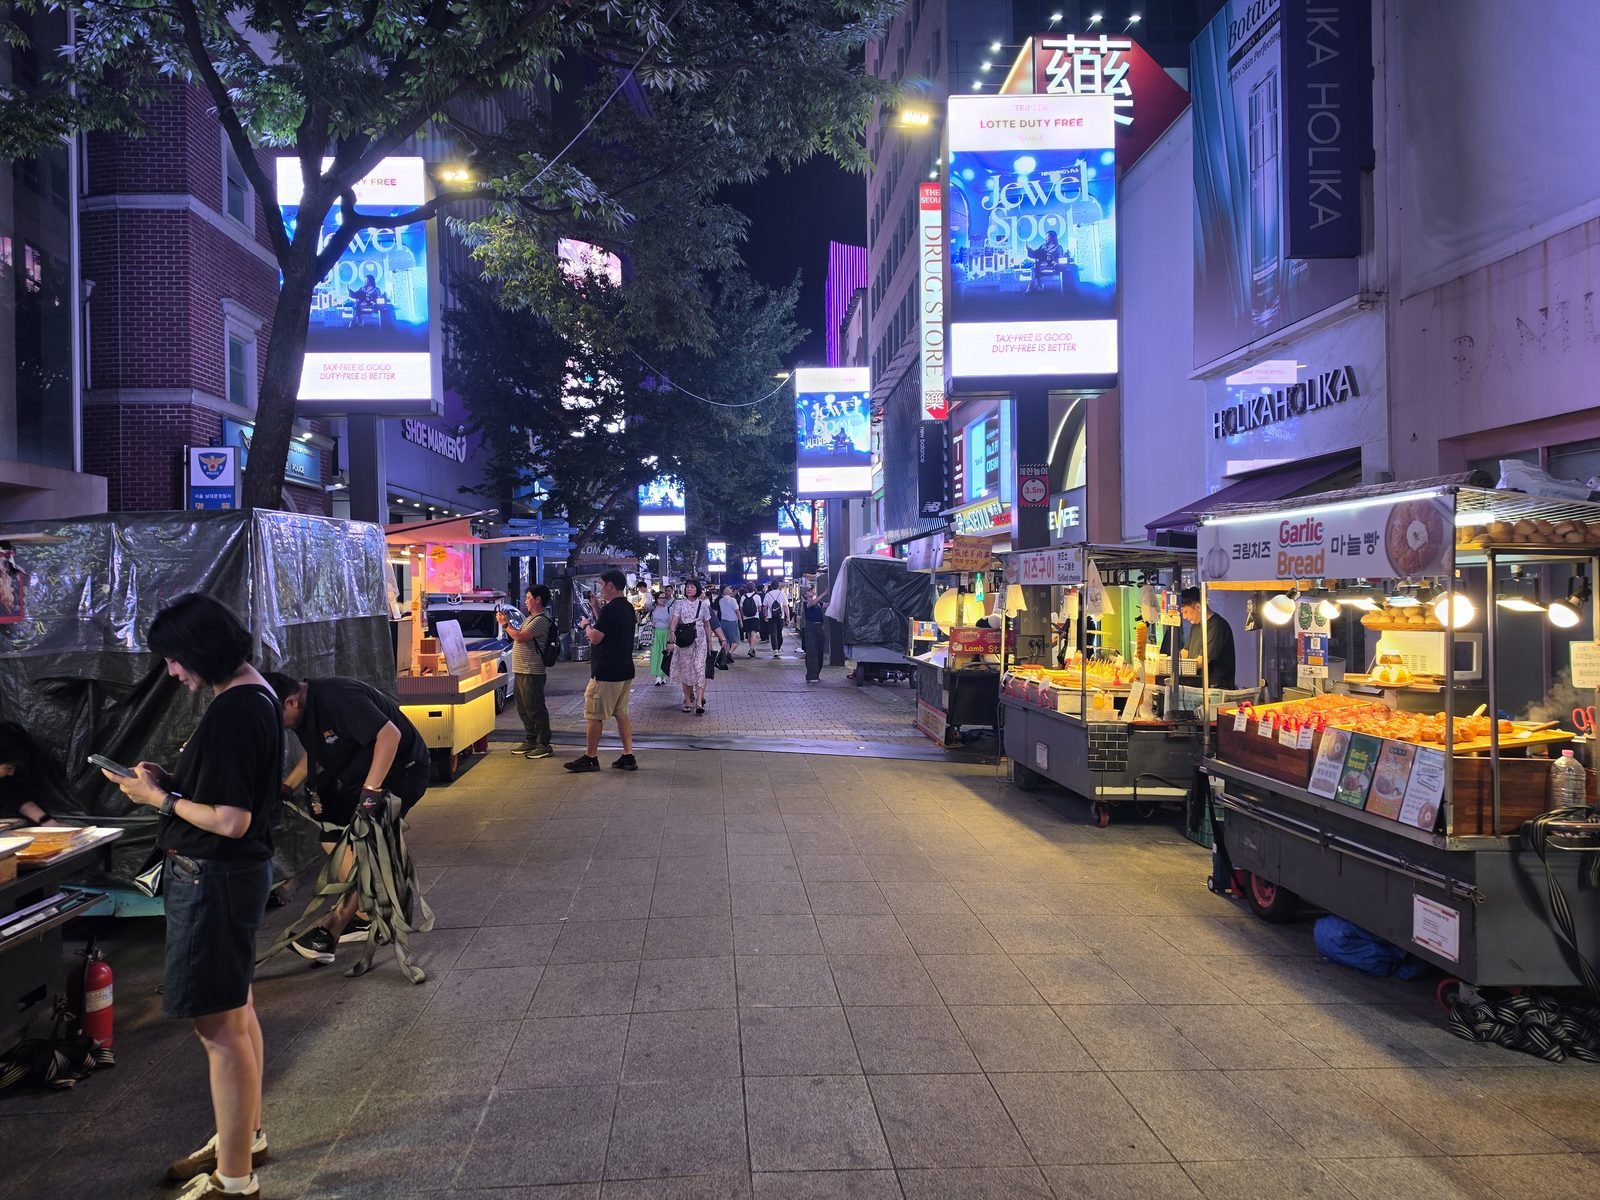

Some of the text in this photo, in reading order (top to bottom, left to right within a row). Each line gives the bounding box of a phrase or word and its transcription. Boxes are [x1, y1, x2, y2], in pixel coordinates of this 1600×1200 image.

[980, 118, 1084, 129] LOTTE DUTY FREE
[1307, 83, 1342, 230] HOLIKA
[371, 178, 397, 187] FREE
[981, 158, 1091, 210] Jewel
[924, 225, 945, 377] DRUG STORE
[992, 342, 1077, 353] DUTY-FREE IS BETTER
[995, 332, 1073, 342] TAX-FREE IS GOOD
[322, 363, 392, 371] TAX-FREE IS GOOD
[405, 419, 457, 461] SHOE MARKER
[1025, 486, 1045, 494] 3.5m
[1279, 518, 1324, 546] Garlic
[1232, 530, 1380, 560] 크림치즈 마늘빵
[1023, 555, 1055, 580] 치즈구이
[1276, 548, 1326, 577] Bread
[964, 644, 984, 652] Lamb
